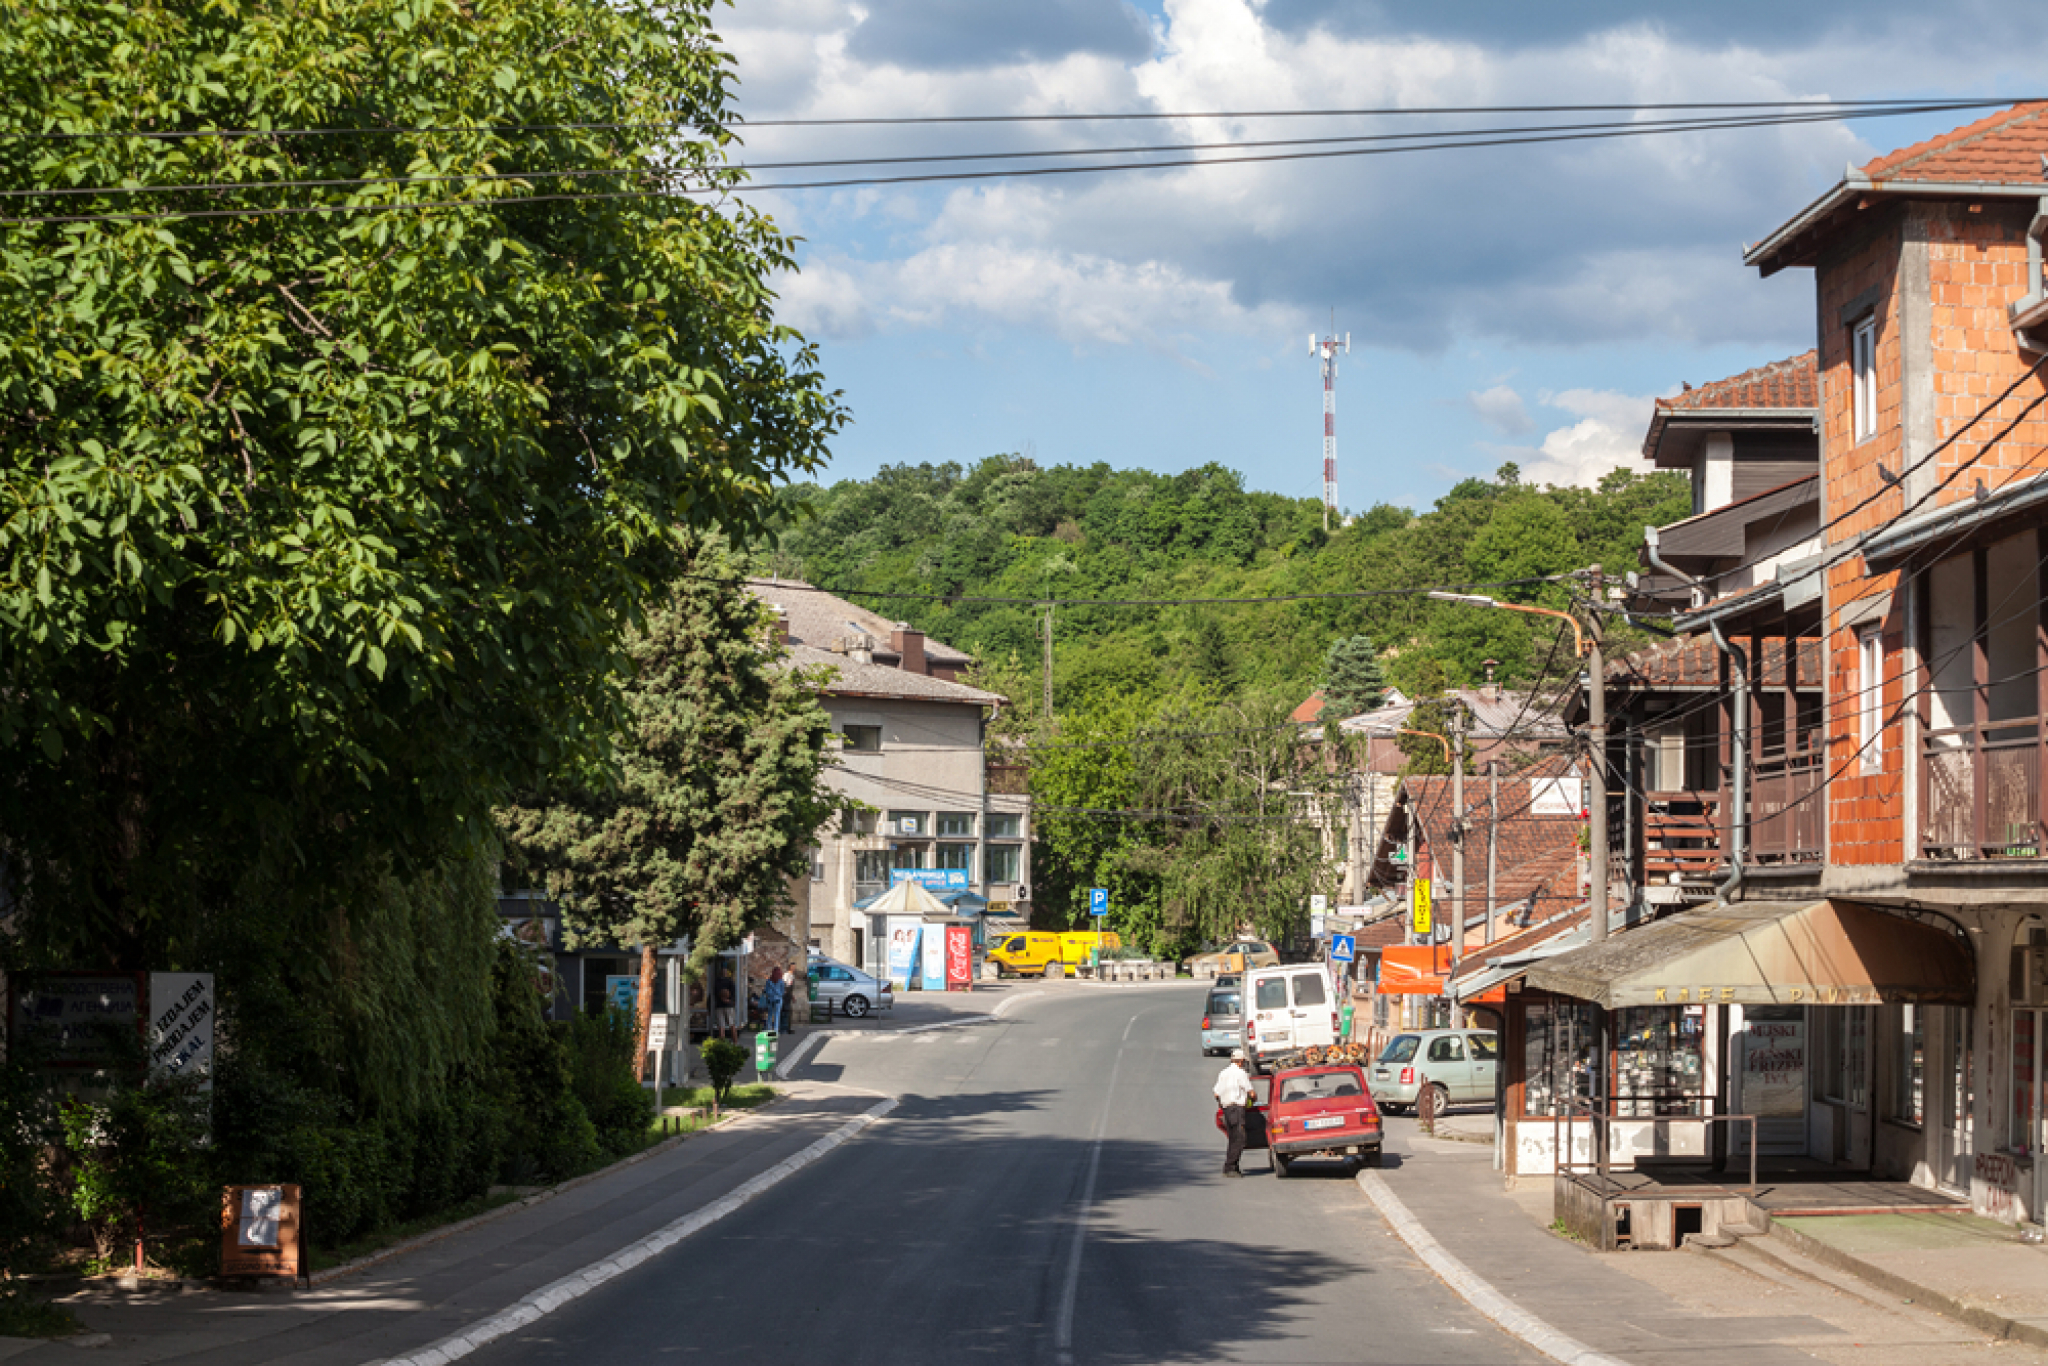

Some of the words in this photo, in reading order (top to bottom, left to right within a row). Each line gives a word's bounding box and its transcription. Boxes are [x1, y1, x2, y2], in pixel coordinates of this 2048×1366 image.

[1095, 891, 1105, 905] P
[155, 979, 206, 1033] IZDAJEM
[1654, 987, 1736, 1004] KAFE
[152, 1000, 211, 1064] PRODAJEM
[167, 1036, 206, 1074] LKAL
